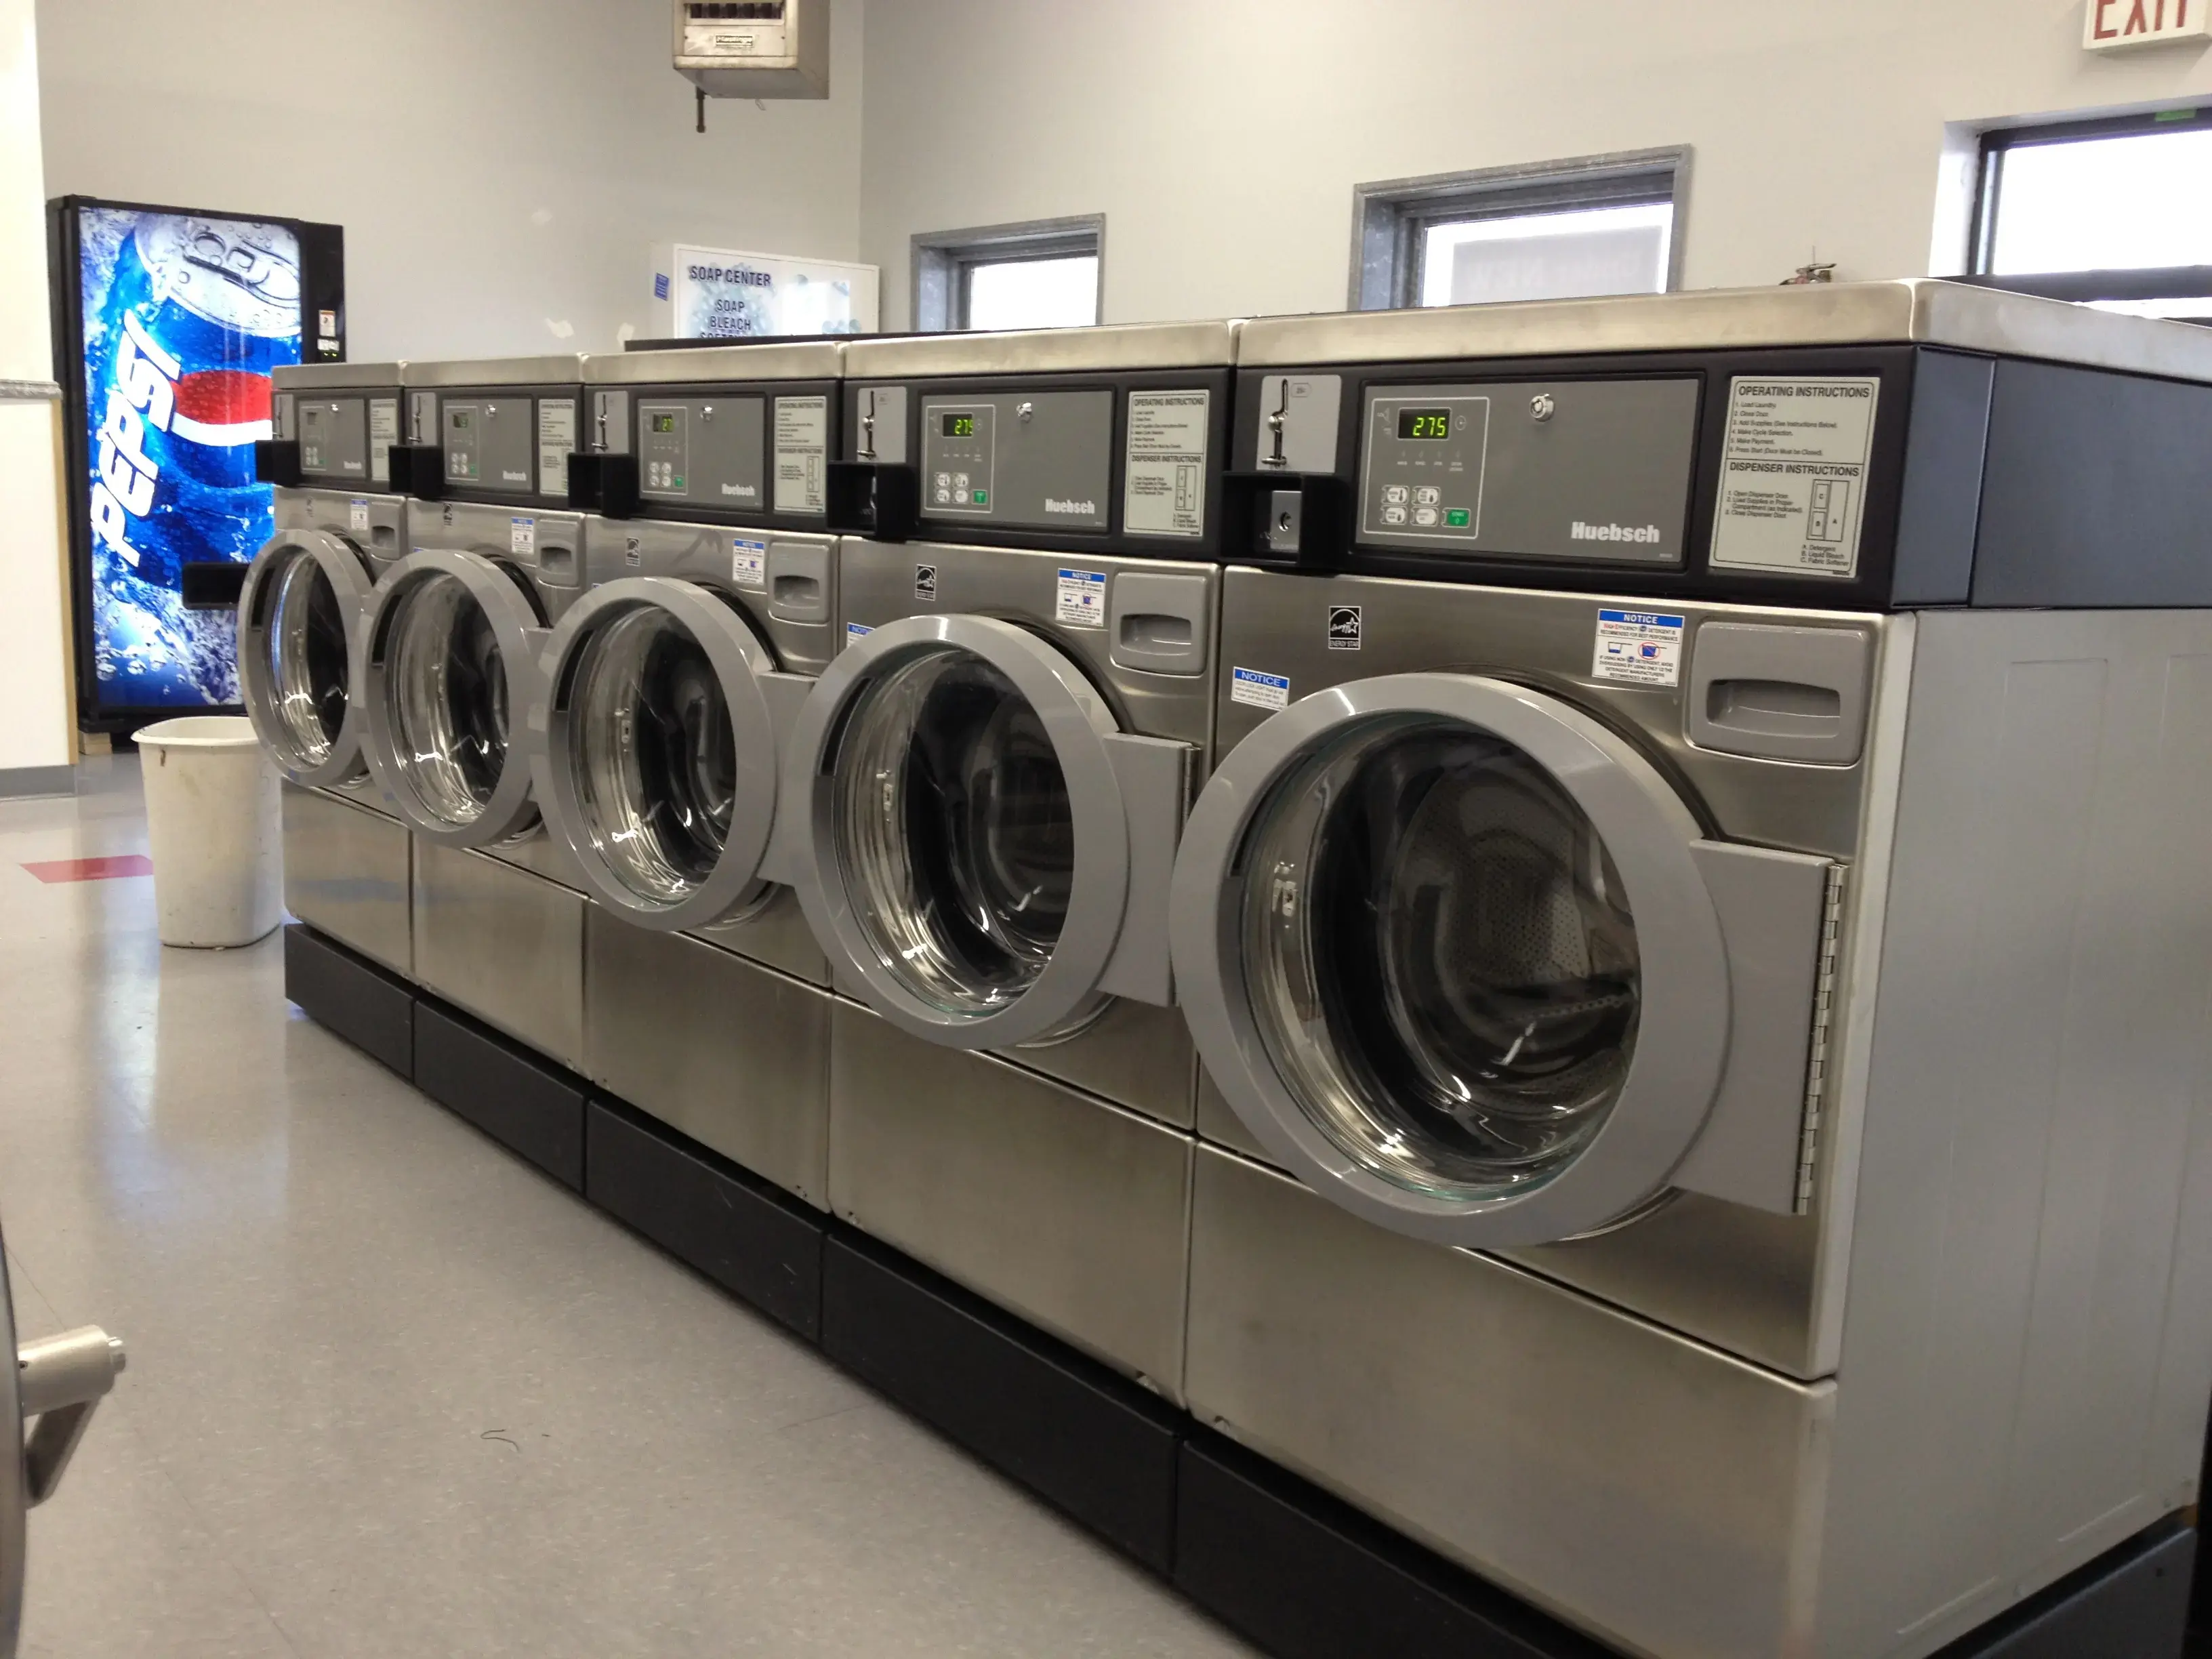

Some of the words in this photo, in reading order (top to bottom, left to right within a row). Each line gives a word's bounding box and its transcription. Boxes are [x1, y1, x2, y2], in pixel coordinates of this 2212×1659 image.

[690, 266, 721, 281] SOAP
[724, 270, 771, 286] CENTER
[715, 300, 745, 312] SOAP
[710, 316, 751, 331] BLEACH
[1738, 386, 1793, 396] OPERATING
[1796, 387, 1869, 397] INSTRUCTIONS
[1412, 417, 1446, 436] 275
[91, 308, 182, 567] PEPSI
[1729, 462, 1783, 472] DISPENSER
[1786, 465, 1859, 476] INSTRUCTIONS
[1571, 521, 1660, 544] Huebsch
[1623, 613, 1658, 624] NOTICE
[1242, 670, 1282, 687] NOTICE
